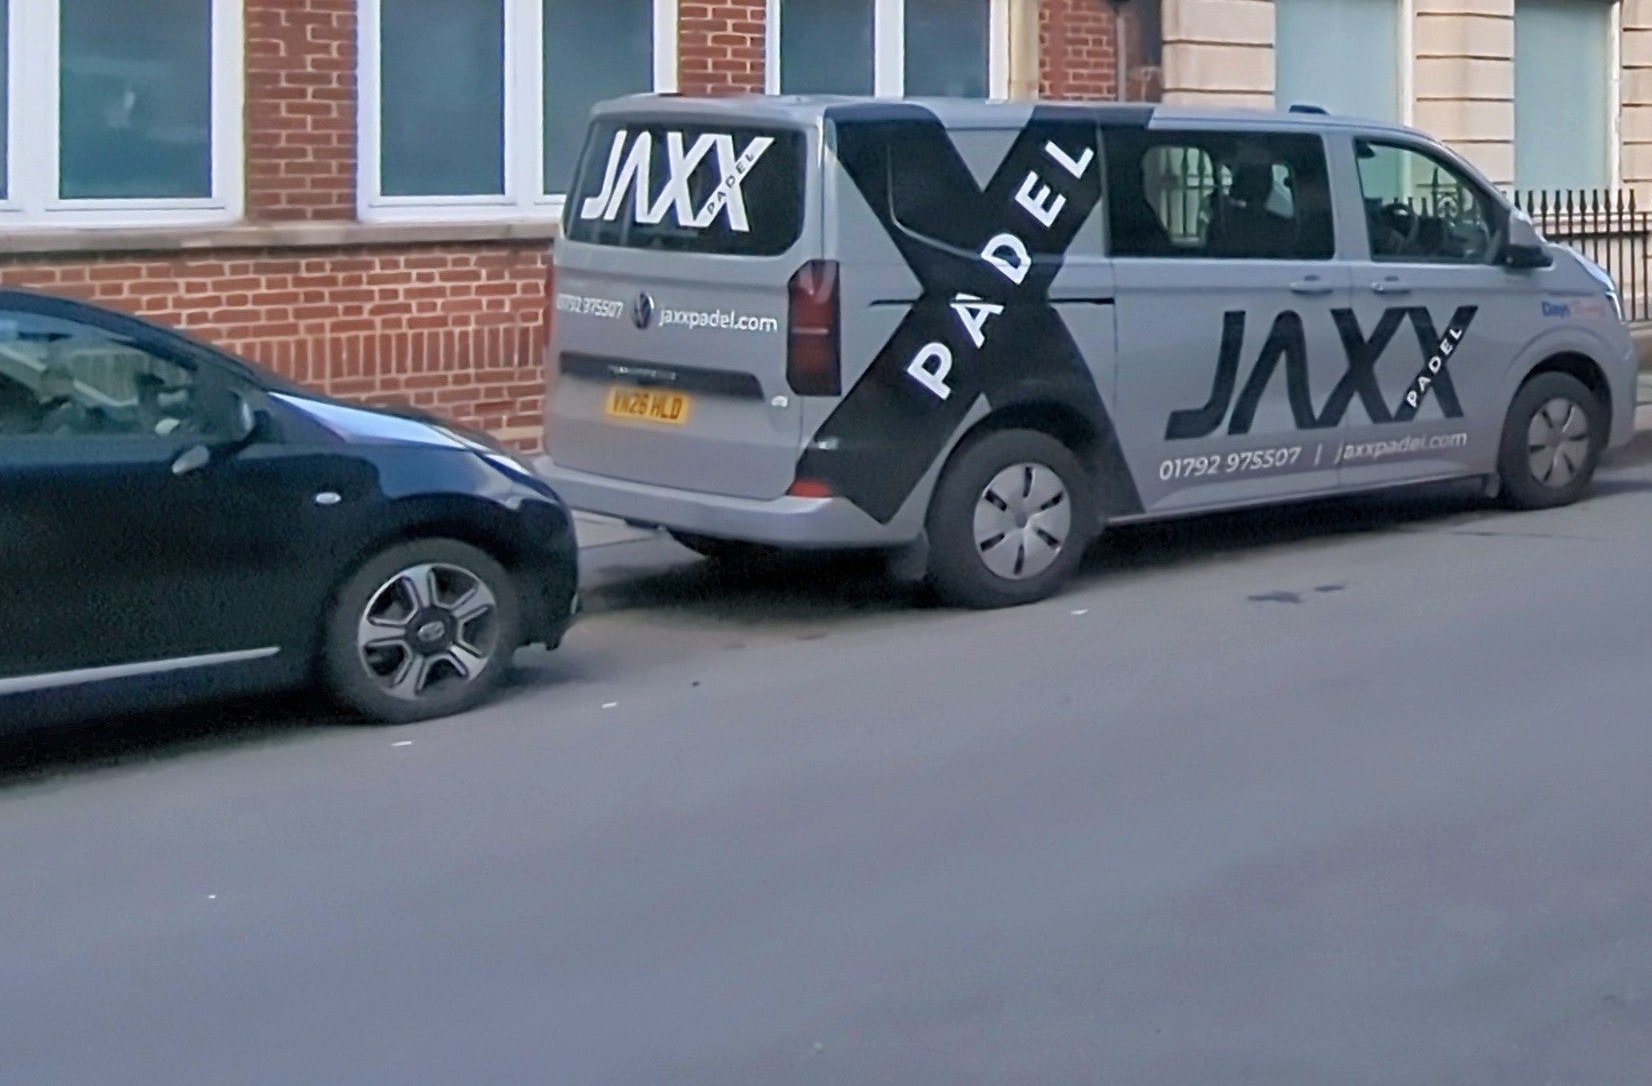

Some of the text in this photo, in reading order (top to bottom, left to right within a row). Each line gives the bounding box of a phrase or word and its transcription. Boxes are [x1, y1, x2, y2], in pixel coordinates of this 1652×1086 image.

[580, 130, 775, 232] JAXX
[707, 153, 754, 215] PADEL
[907, 140, 1094, 400] PADEL
[659, 310, 778, 333] jaxxpadel.com
[1165, 305, 1478, 441] JAXX
[1407, 328, 1462, 407] PADEL
[1159, 455, 1221, 480] 01792
[1226, 446, 1302, 473] 975507
